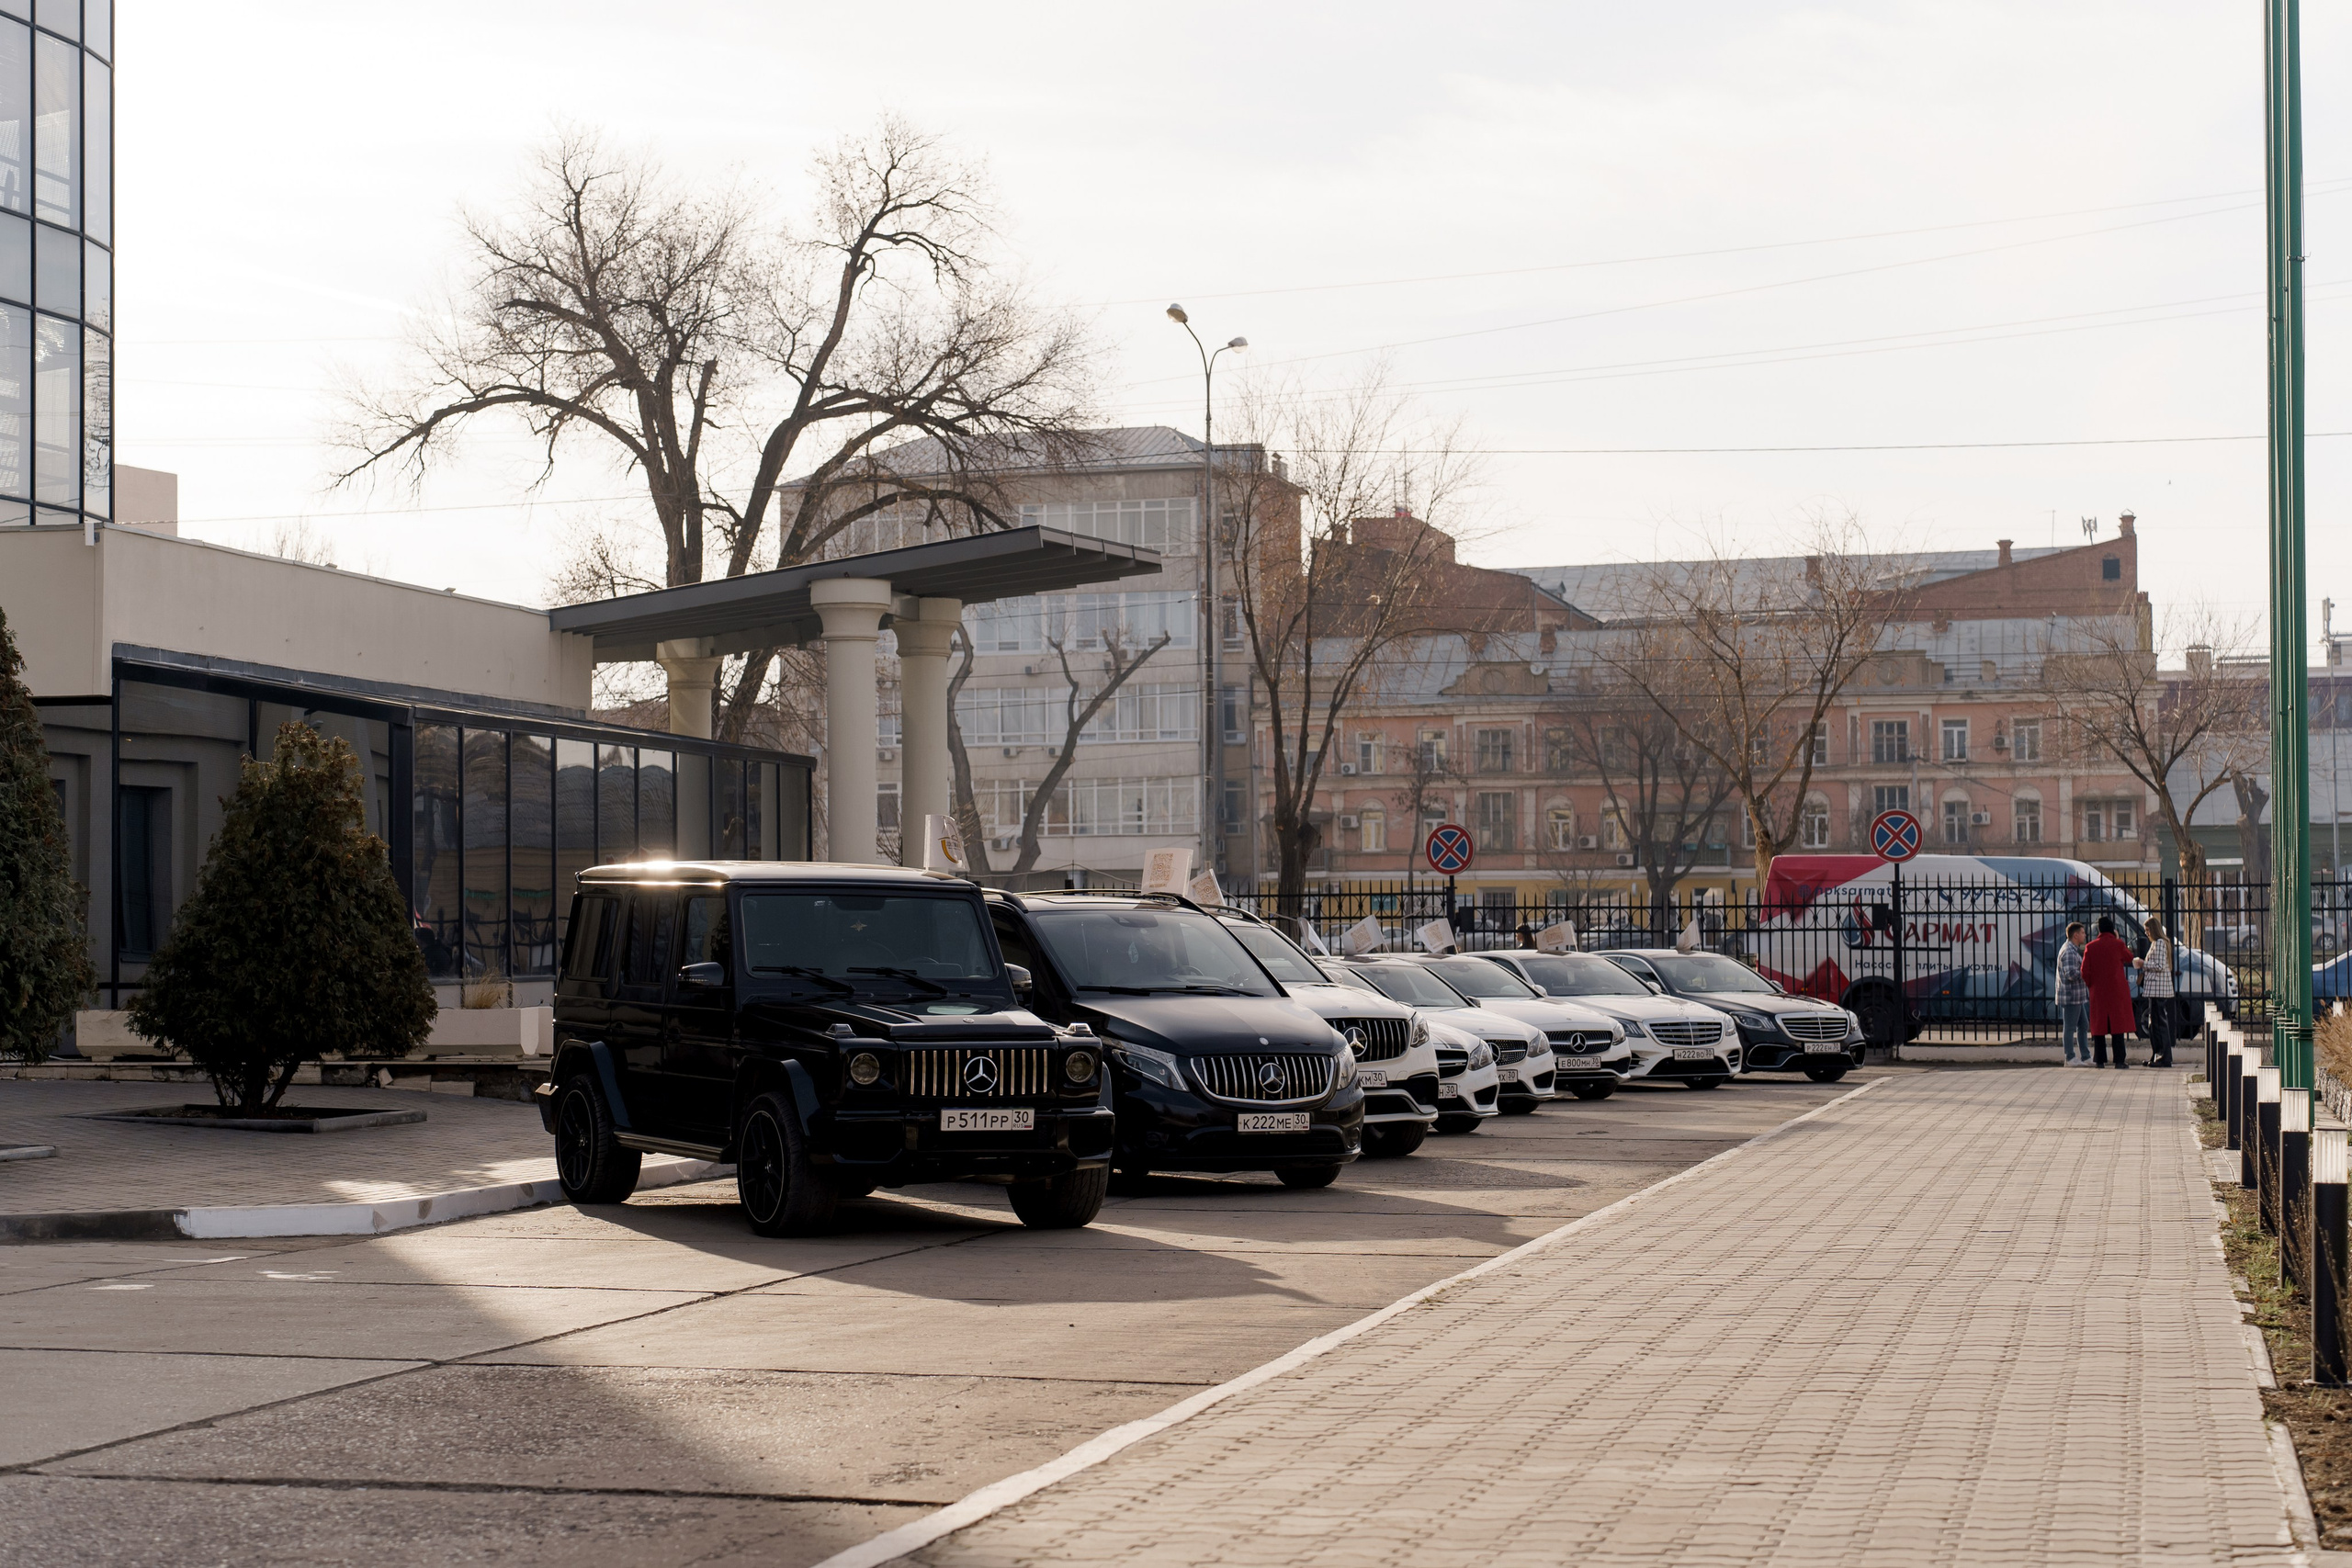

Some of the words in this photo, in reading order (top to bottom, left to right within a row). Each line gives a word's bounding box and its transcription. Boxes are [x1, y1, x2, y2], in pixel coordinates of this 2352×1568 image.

[1855, 959, 1897, 969] Насос
[1373, 1072, 1383, 1082] 30
[1446, 1085, 1454, 1094] 30
[947, 1111, 1009, 1128] Р511РР
[1013, 1111, 1029, 1123] 30
[1243, 1115, 1292, 1130] К222МЕ
[1295, 1113, 1306, 1125] 30
